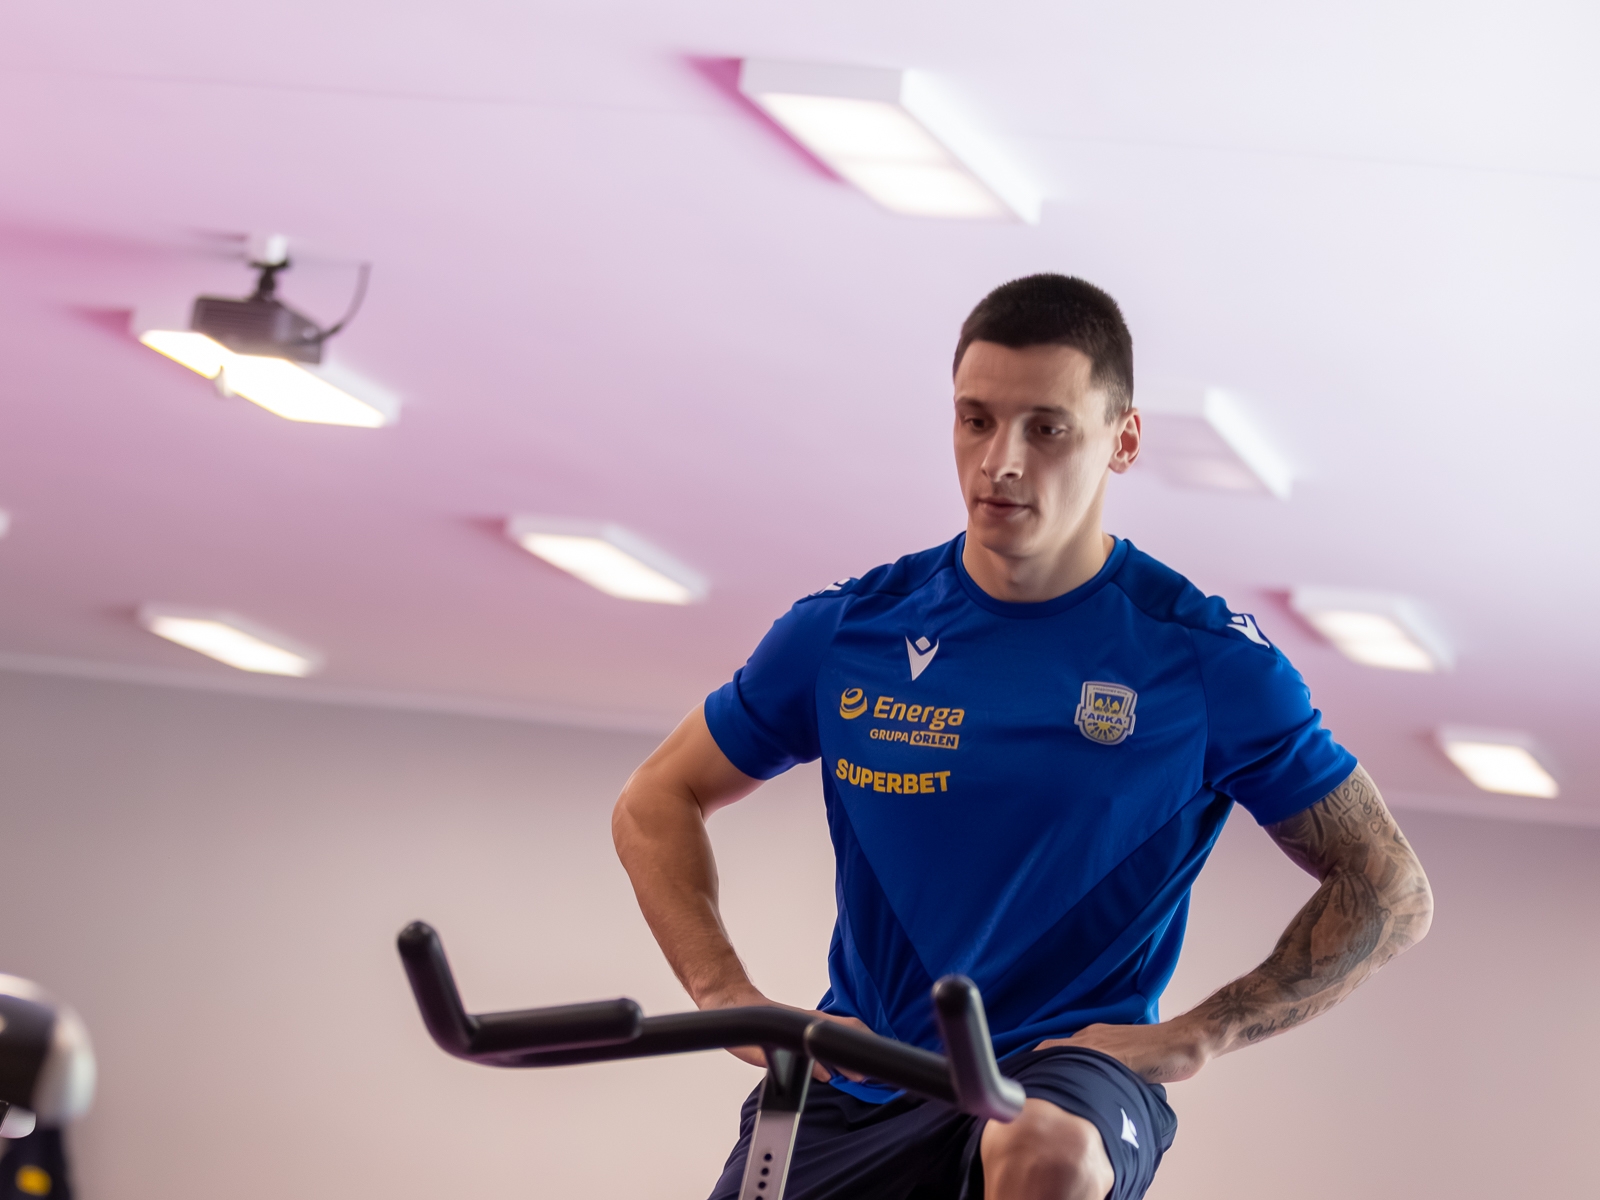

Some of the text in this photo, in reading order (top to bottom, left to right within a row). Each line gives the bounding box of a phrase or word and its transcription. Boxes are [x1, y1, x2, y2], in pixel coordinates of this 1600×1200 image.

[873, 696, 965, 731] Energa
[1086, 712, 1124, 726] ARKA
[869, 728, 958, 748] GRUPA ORLEN
[835, 758, 951, 795] SUPERBET
